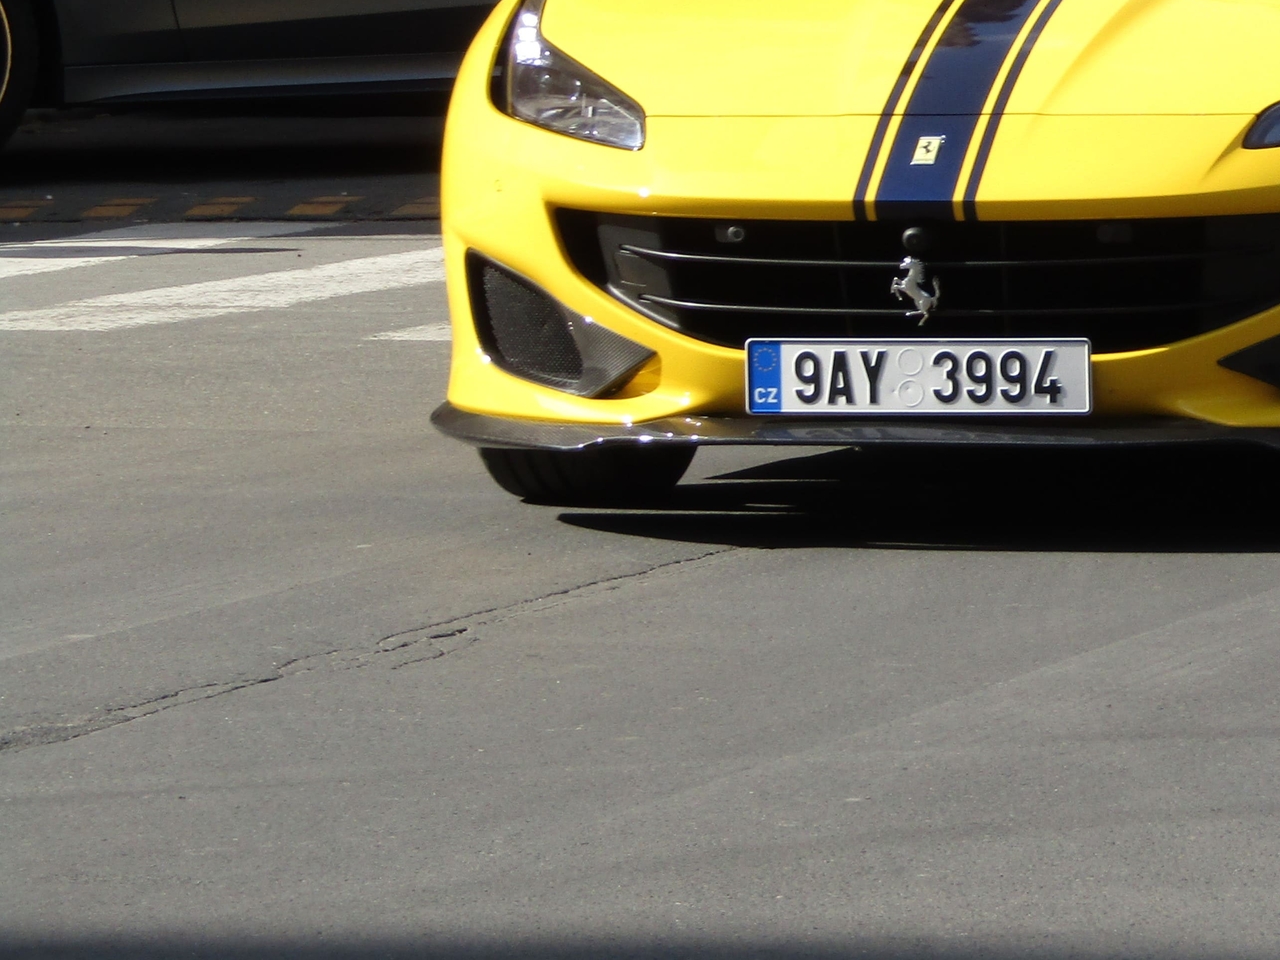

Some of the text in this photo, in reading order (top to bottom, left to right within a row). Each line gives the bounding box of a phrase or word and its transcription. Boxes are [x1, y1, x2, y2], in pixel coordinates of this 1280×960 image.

[792, 349, 1063, 405] 9AY 3994
[754, 387, 778, 404] CZ
